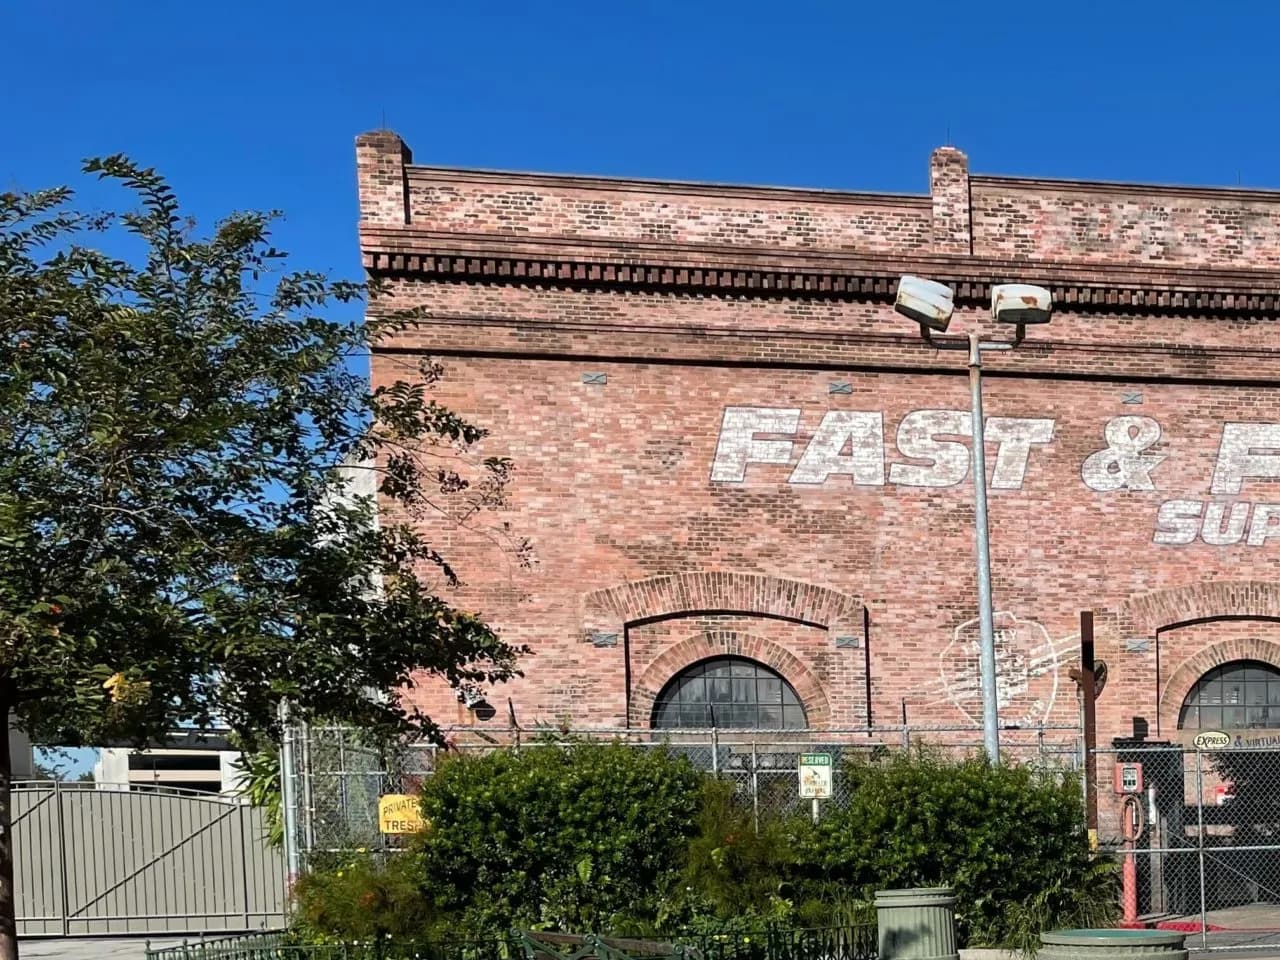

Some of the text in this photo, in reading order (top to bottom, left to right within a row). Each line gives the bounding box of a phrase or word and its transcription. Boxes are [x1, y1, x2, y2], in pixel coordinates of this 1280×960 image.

[710, 406, 1054, 490] FAST
[1080, 415, 1169, 491] &
[1196, 736, 1227, 747] EXPRESS
[1246, 735, 1280, 747] VIRTUAL
[383, 798, 418, 817] PRIVATE
